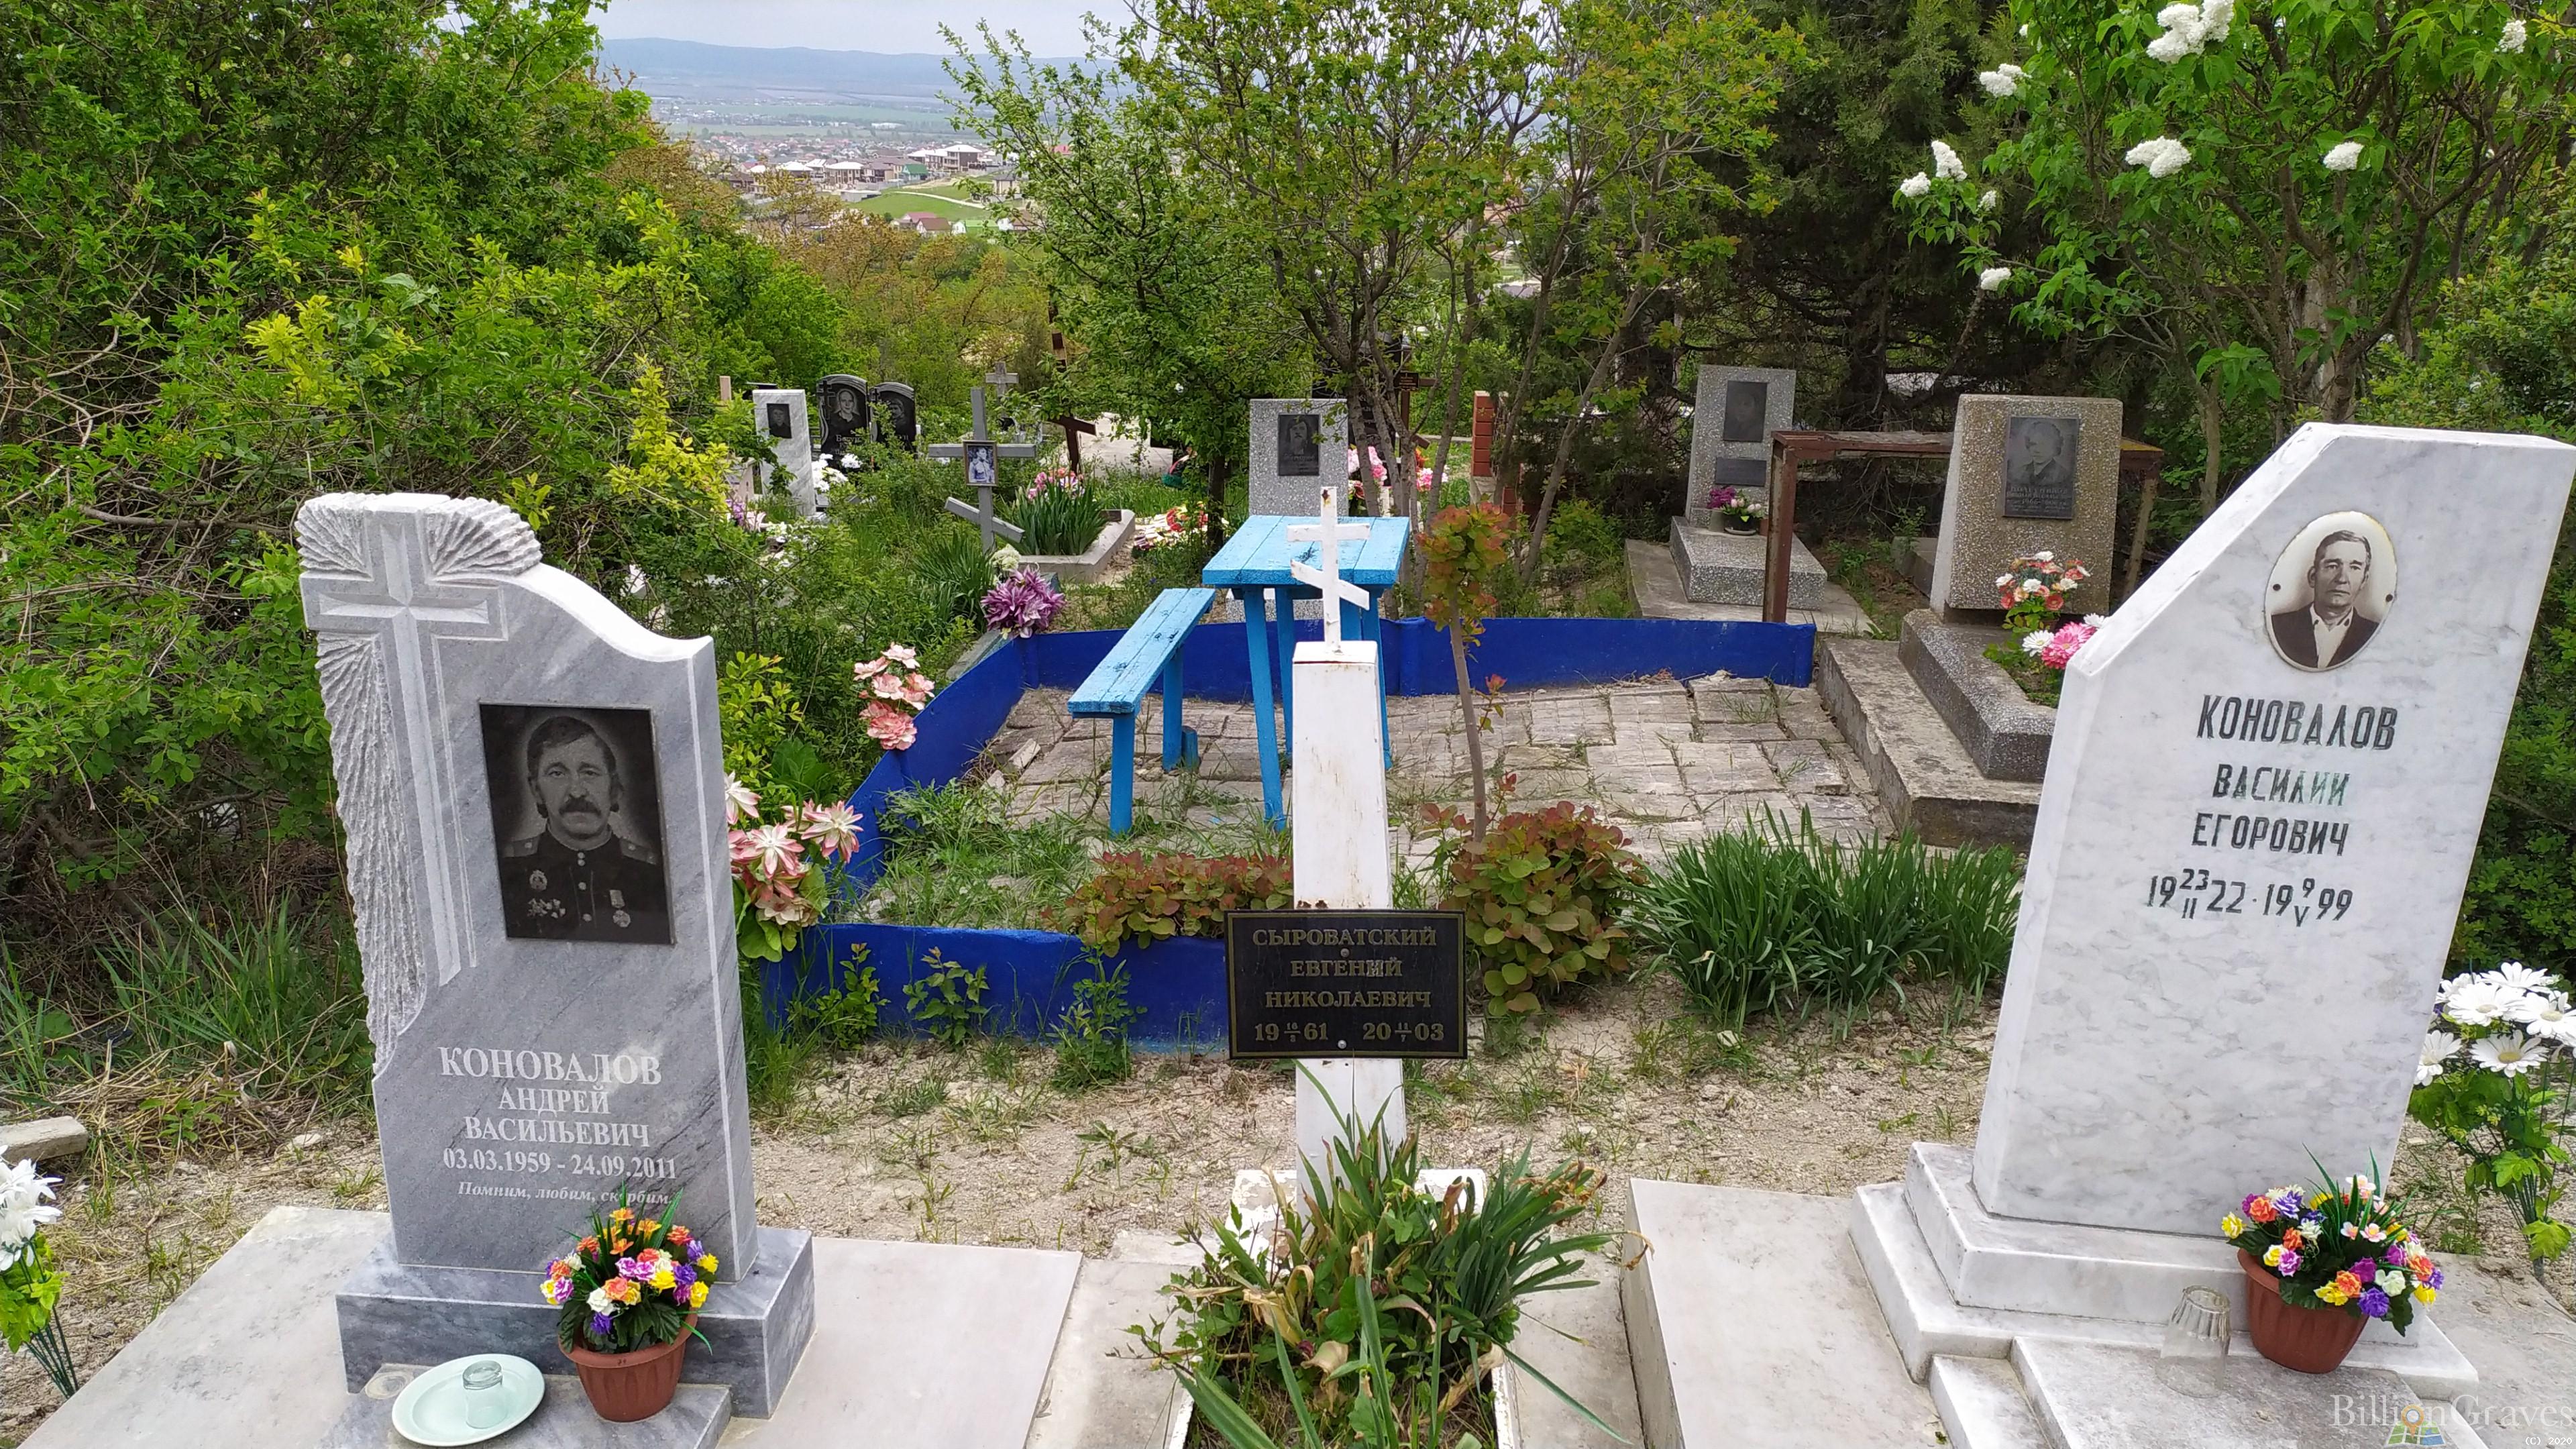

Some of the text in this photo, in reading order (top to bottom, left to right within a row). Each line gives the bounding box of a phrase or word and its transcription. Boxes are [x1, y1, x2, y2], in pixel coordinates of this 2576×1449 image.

[2196, 694, 2398, 750] КОНОВАЛОВ
[2191, 812, 2349, 857] ЕГОРОВИЧ
[1252, 926, 1437, 947] СЫРОВАТСКИЙ
[1290, 957, 1403, 977] ЕВГЕНИЙ
[1265, 991, 1432, 1008] НИКОЛАЕВИЧ
[437, 1047, 662, 1085] КОНОВАЛОВ
[498, 1081, 610, 1116] АНДРЕЙ
[464, 1116, 649, 1147] ВАСИЛЬЕВИЧ
[443, 1148, 551, 1173] 03.03.1959
[572, 1155, 677, 1179] 24.09.2011
[458, 1181, 672, 1206] Помним, любим, скрбим.
